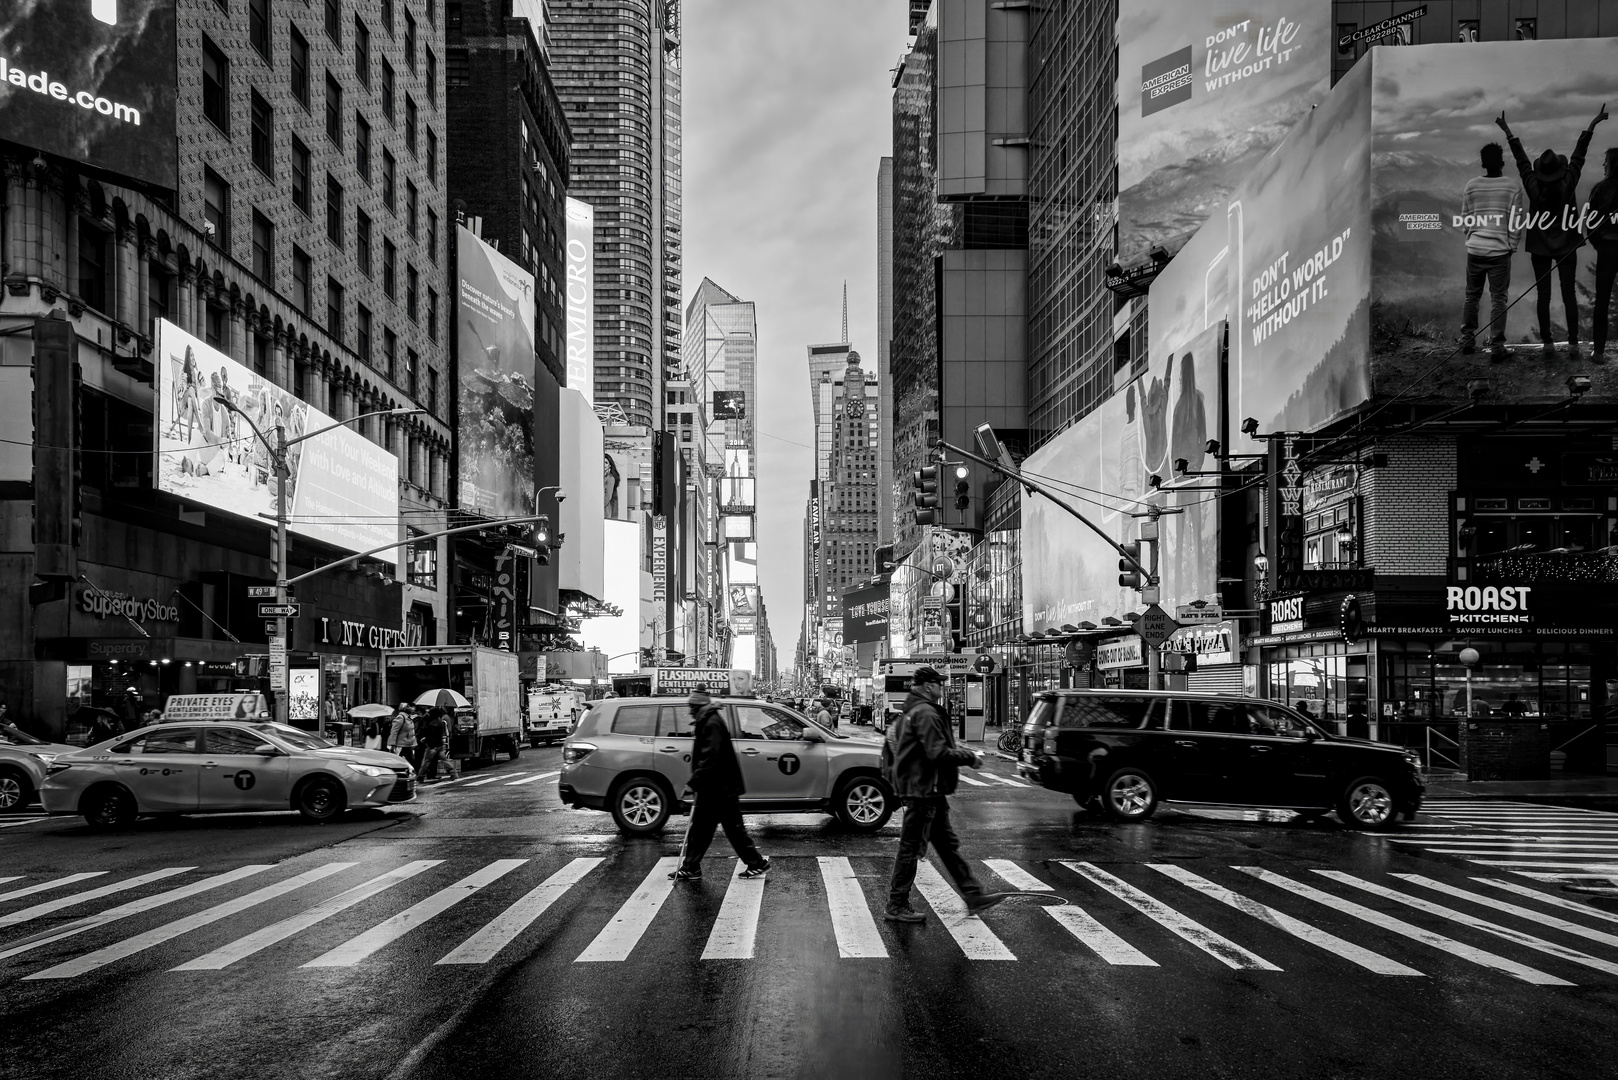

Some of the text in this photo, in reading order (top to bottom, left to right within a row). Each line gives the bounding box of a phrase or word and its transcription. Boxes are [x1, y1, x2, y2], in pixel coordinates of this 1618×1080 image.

[1205, 19, 1250, 49] DON'T
[1365, 27, 1397, 43] 022280
[1205, 17, 1301, 78] live life
[1141, 64, 1189, 92] AMERICAN
[1205, 48, 1292, 92] WITHOUT IT
[1150, 73, 1192, 99] EXPRESS
[1399, 213, 1439, 222] AMERICAN
[1406, 221, 1442, 230] EXPRESS
[1452, 214, 1503, 228] DON'T
[1508, 205, 1557, 233] live
[1561, 202, 1604, 234] life
[1252, 251, 1289, 300] DON'T
[1252, 275, 1328, 346] WITHOUT IT.
[339, 435, 360, 462] Your
[361, 447, 396, 482] Weekend
[308, 449, 397, 503] with Love and Altitude
[304, 495, 316, 510] The
[653, 521, 665, 602] NFL EXPERIENCE
[256, 588, 263, 596] 49
[1446, 586, 1531, 611] ROAST
[866, 598, 890, 616] YOURSE
[1271, 597, 1304, 623] ROAST
[1275, 622, 1298, 632] KITCHEN
[1459, 614, 1520, 623] KITCHEN
[321, 617, 329, 643] I
[369, 625, 407, 649] GIFTS
[498, 632, 510, 653] BA
[1145, 631, 1165, 639] ENDS
[1194, 633, 1228, 654] PIZZA
[659, 670, 729, 681] FLASHDANCERS
[710, 681, 729, 689] CLUB
[170, 697, 234, 707] PRIVATE EYES
[1385, 705, 1392, 713] A
[783, 757, 796, 773] T
[238, 773, 251, 788] T
